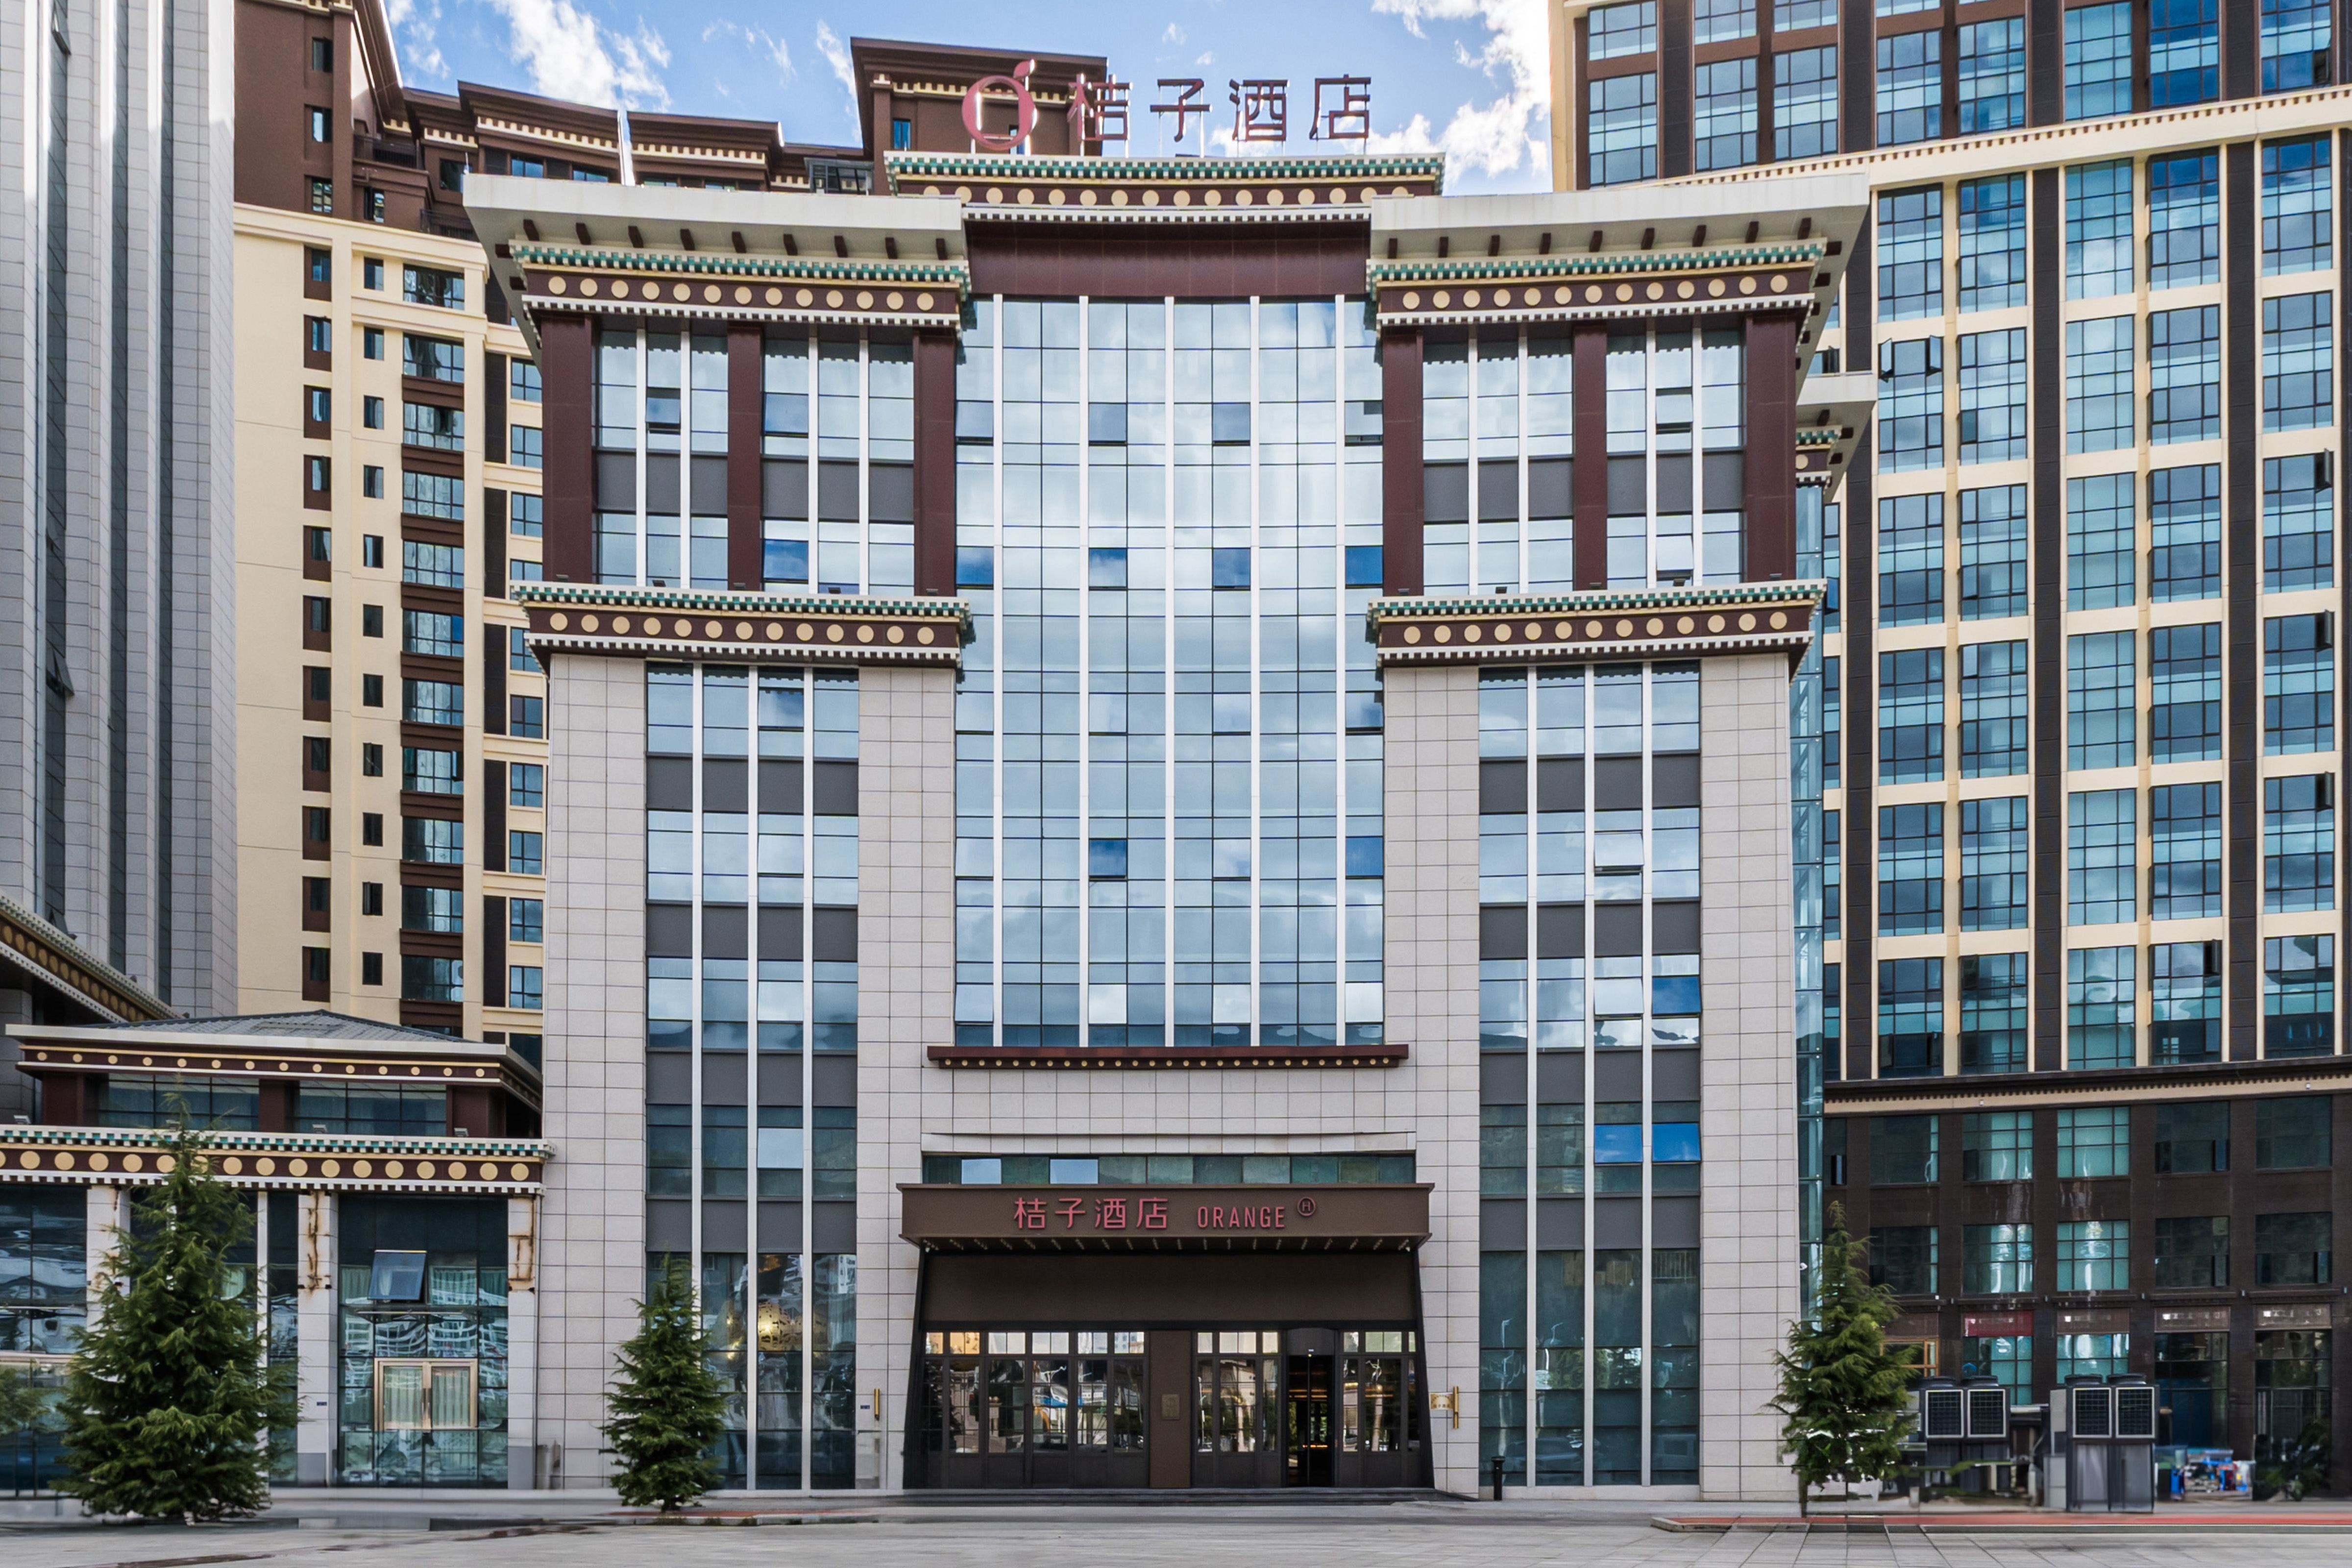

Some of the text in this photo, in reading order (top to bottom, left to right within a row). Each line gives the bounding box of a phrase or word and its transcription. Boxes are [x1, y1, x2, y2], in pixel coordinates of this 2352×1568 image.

[1068, 73, 1372, 141] 桔子酒店
[1013, 1197, 1169, 1229] 桔子酒店
[1197, 1206, 1285, 1228] ORANGE
